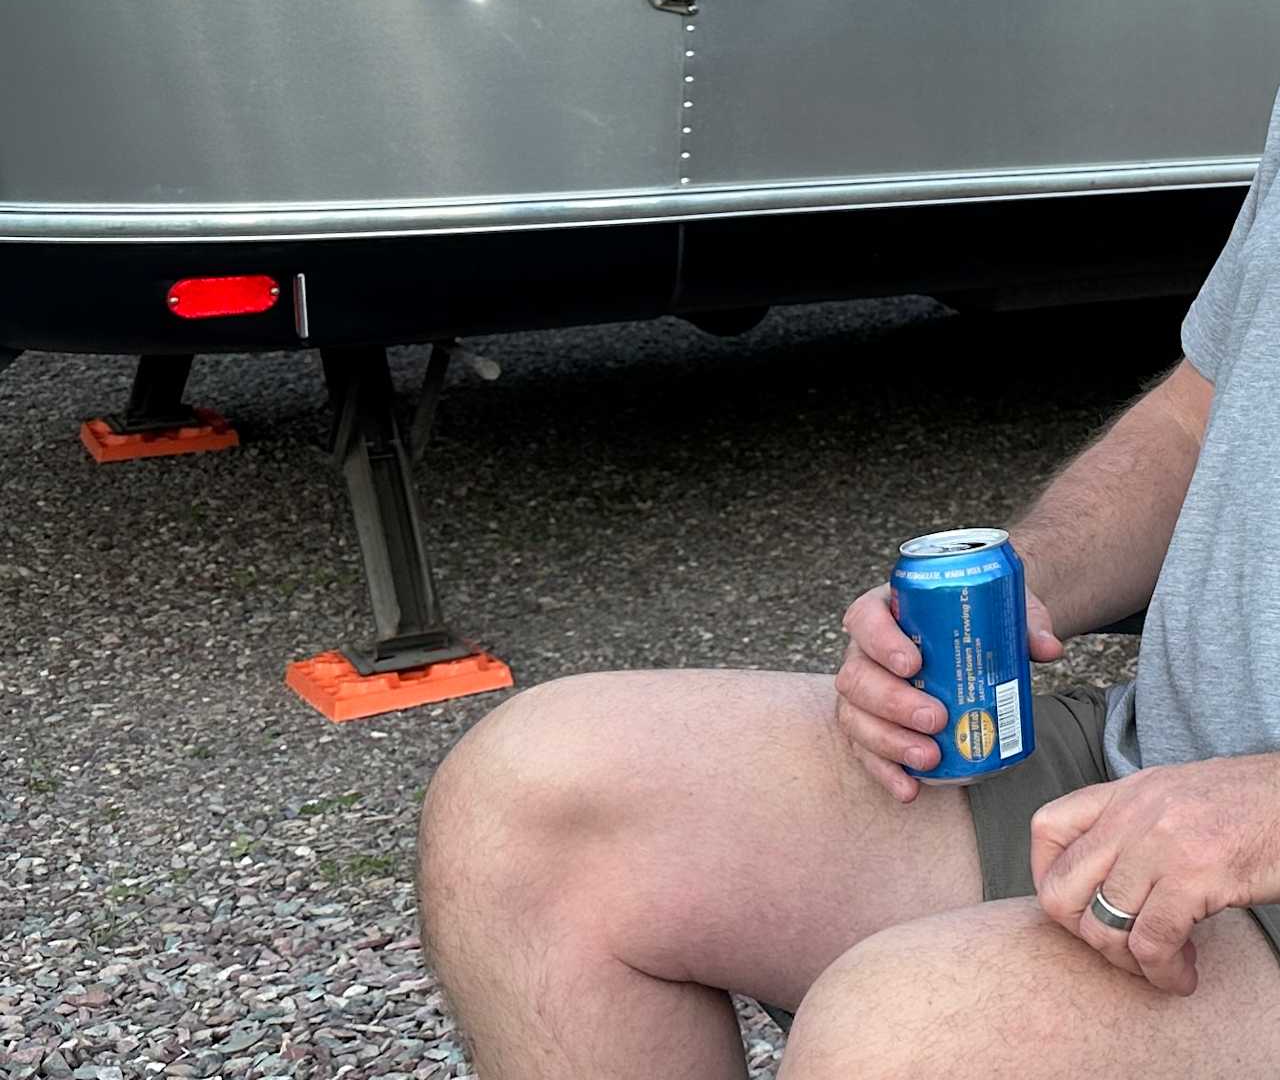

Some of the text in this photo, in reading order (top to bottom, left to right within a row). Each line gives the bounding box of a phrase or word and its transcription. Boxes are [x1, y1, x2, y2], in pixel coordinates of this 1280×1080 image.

[959, 584, 976, 703] Georgetown Brewing Co.
